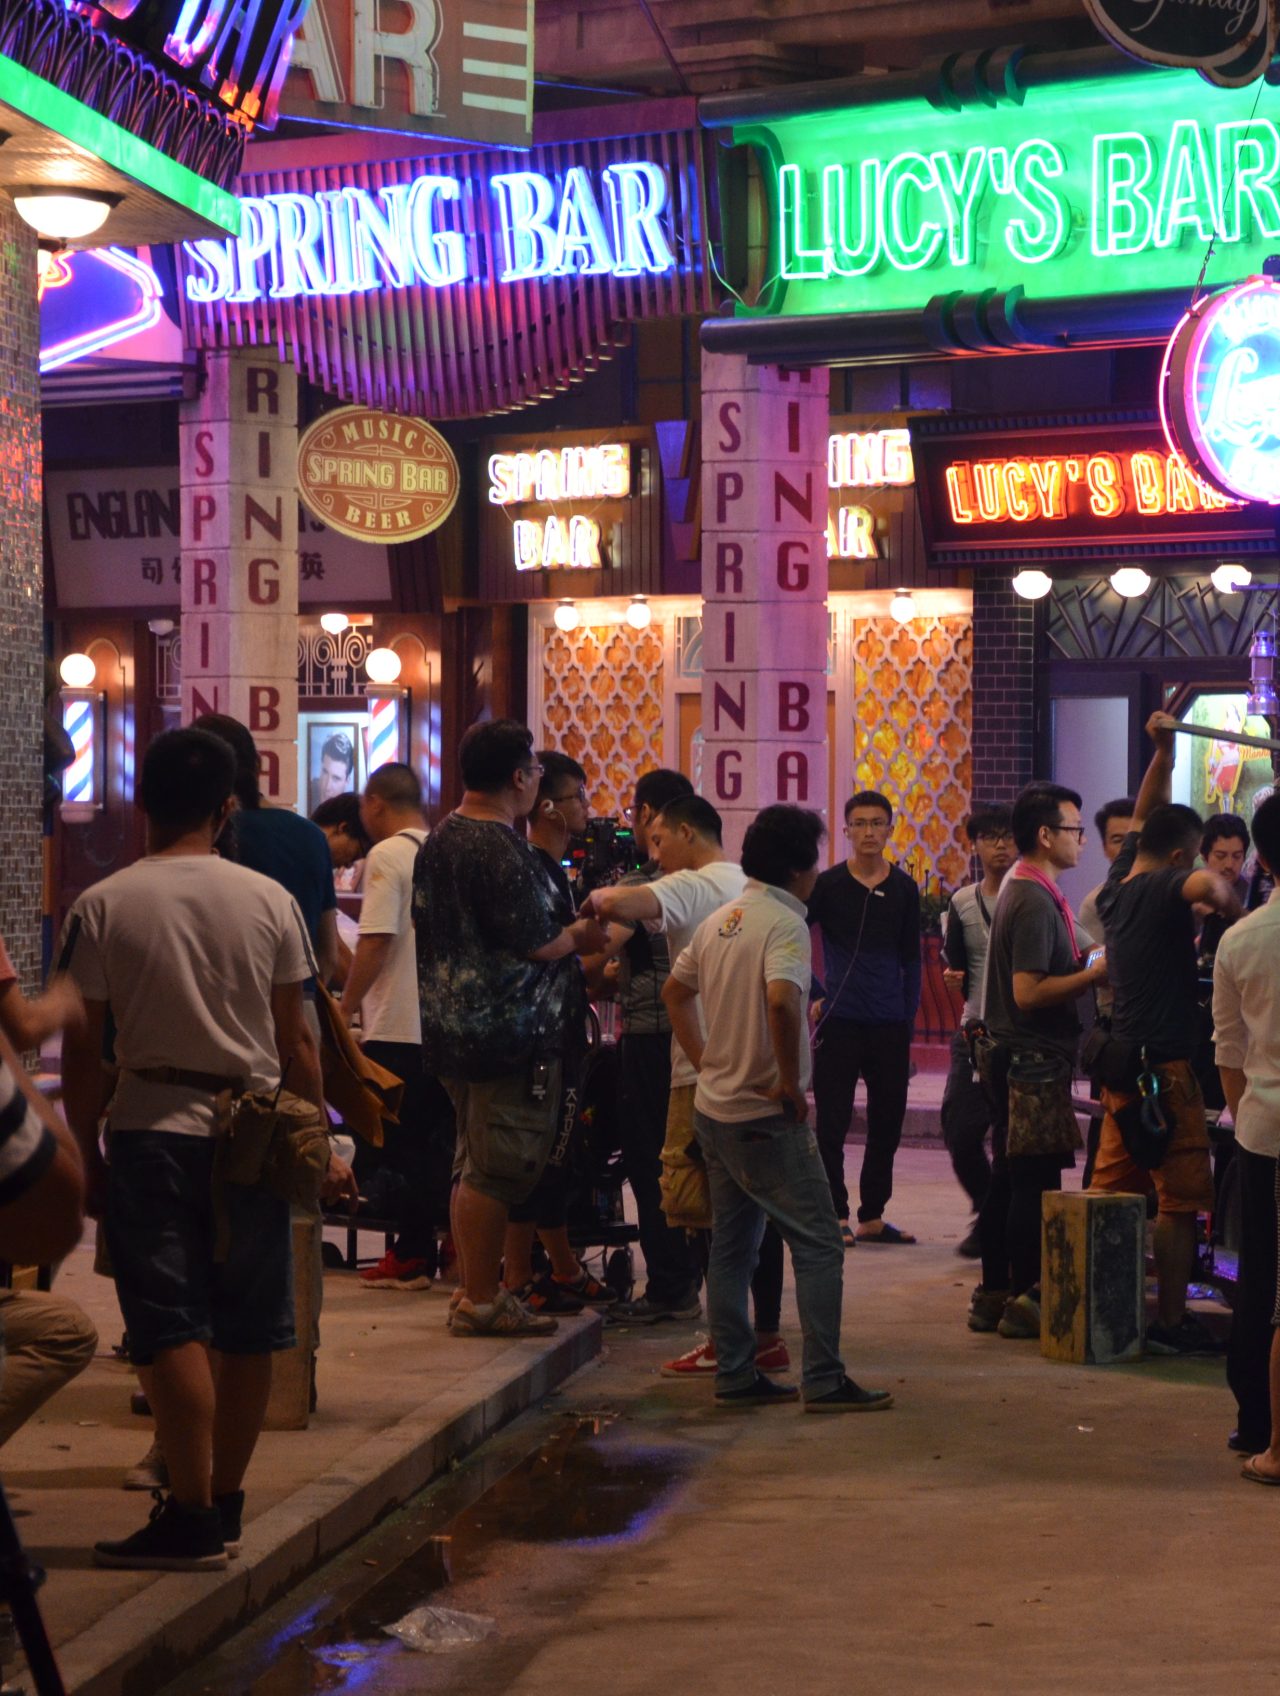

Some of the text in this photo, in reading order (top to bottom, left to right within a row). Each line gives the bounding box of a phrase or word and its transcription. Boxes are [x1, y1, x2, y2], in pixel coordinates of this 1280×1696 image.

[183, 161, 676, 302] SPRING BAR
[779, 138, 1065, 279] LUCY'S
[341, 419, 417, 449] MUSIC
[307, 453, 449, 494] SPRING BAR
[488, 443, 631, 504] SPRING
[775, 366, 813, 592] ING
[945, 453, 1121, 523] LUCY'S
[66, 487, 180, 541] ENGLAN
[345, 504, 411, 529] BEER
[513, 515, 602, 571] BAR
[714, 401, 745, 800] SPRING
